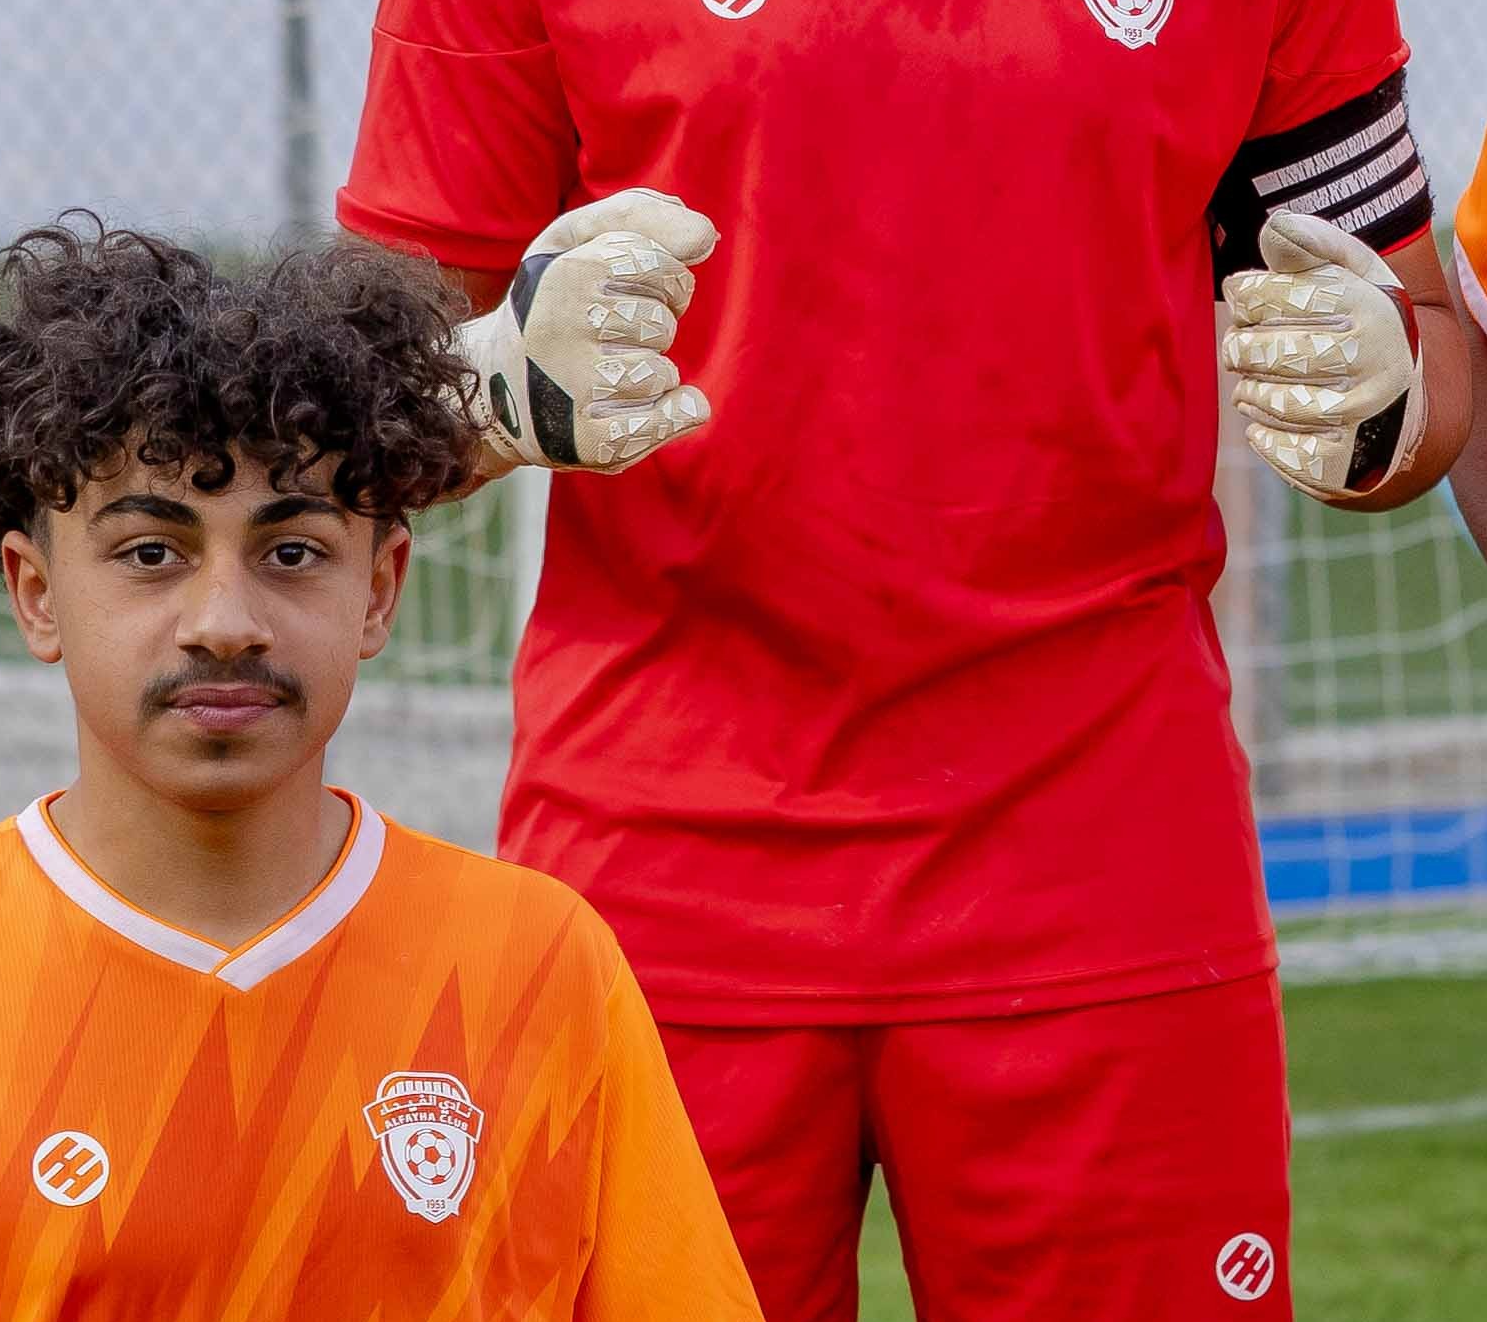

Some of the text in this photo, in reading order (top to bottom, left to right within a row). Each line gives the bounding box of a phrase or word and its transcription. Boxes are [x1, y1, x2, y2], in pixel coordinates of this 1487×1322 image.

[1124, 27, 1143, 38] 1953
[384, 1112, 469, 1131] ALFAYHA CLUB
[426, 1199, 446, 1210] 1953
